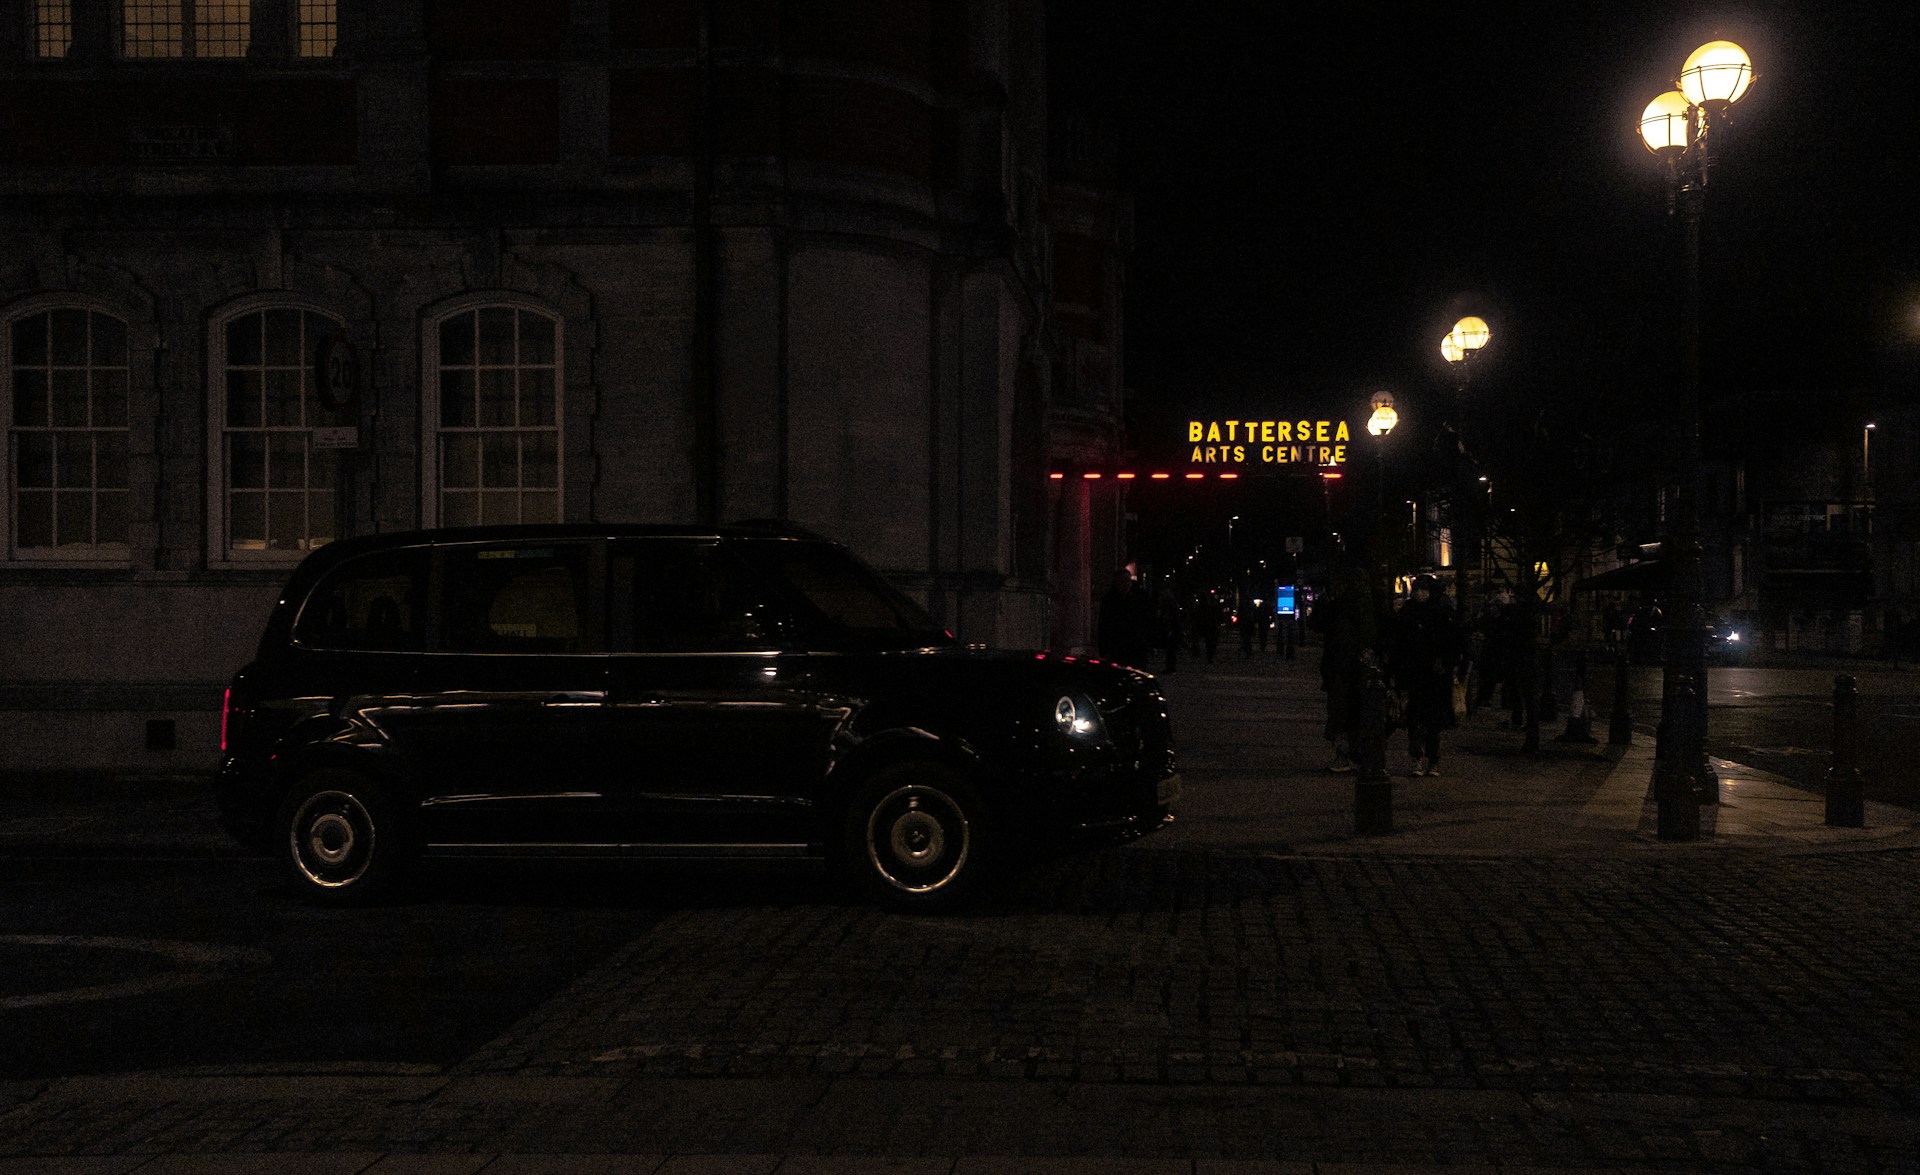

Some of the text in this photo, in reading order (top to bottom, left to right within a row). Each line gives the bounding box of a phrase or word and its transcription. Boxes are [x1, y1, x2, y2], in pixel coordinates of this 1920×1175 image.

[1189, 420, 1350, 443] BATTERSEA
[1191, 445, 1347, 463] ARTS CENTRE
